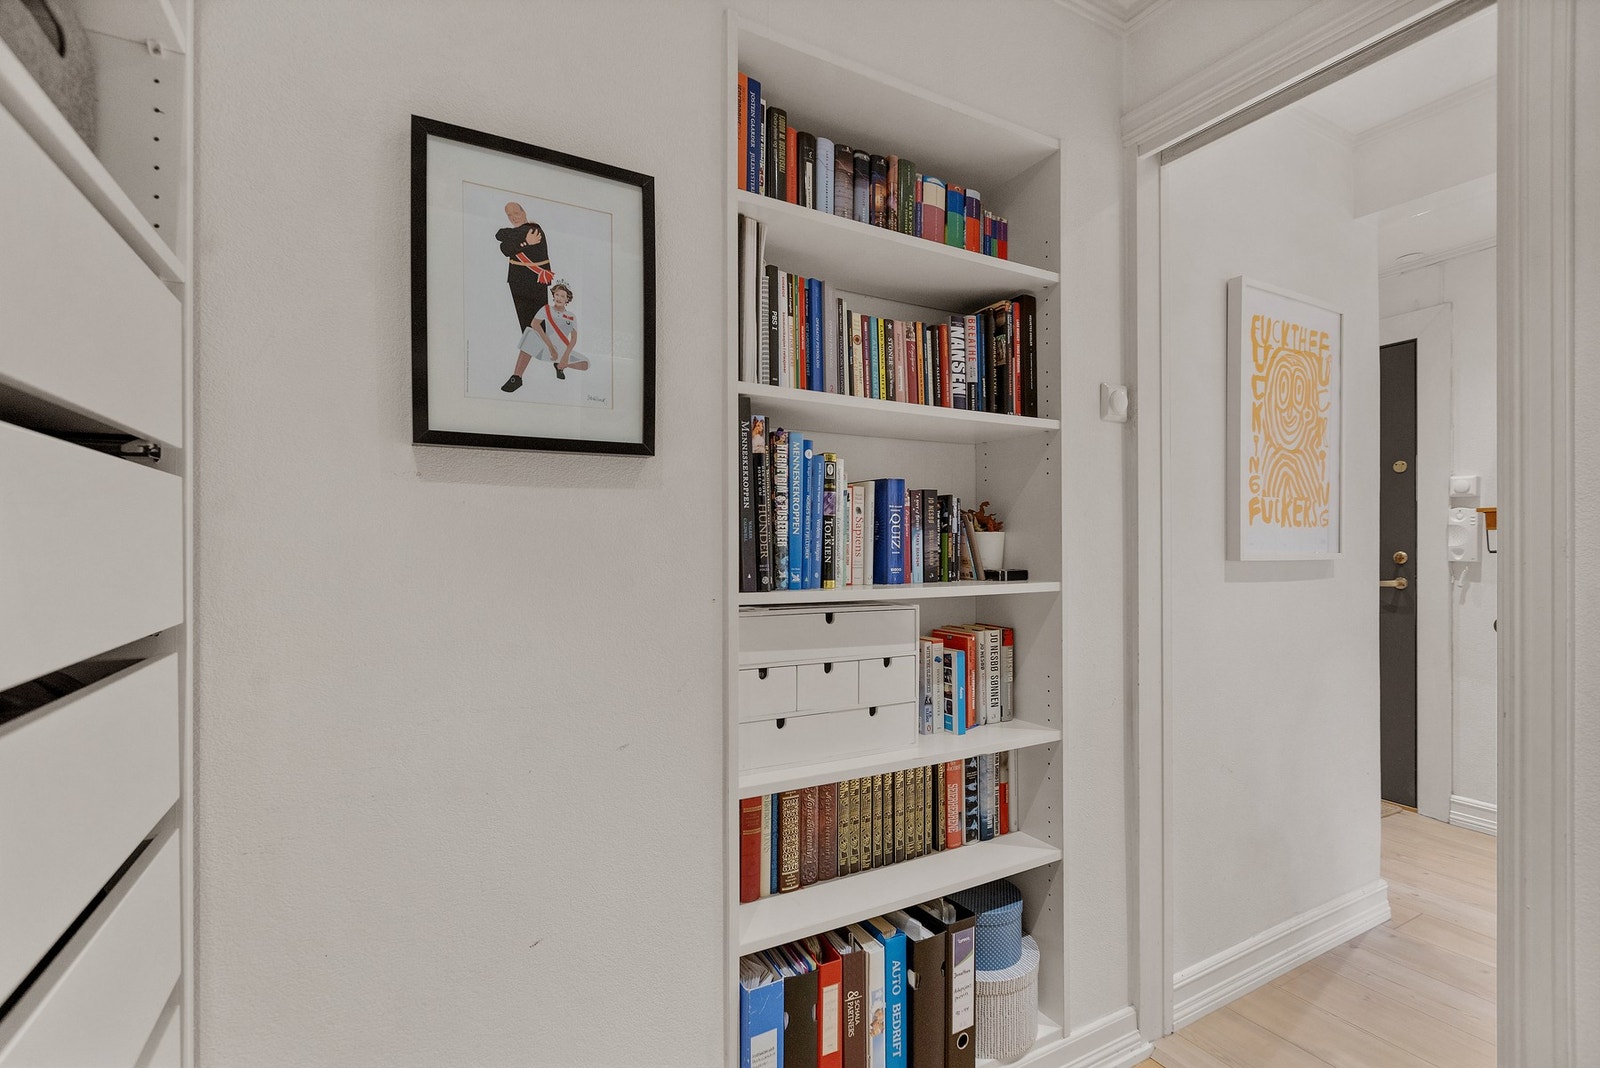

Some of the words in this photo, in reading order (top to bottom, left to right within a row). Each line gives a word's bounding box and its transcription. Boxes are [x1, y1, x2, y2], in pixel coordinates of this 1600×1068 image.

[967, 318, 977, 362] BREATHE
[951, 326, 966, 395] NANSEN
[740, 420, 750, 509] MENNESKEKROPPEN
[775, 444, 788, 493] HJERNETRIM
[792, 441, 801, 535] MENNESKEKROPPEN
[758, 504, 769, 559] HUNDER
[815, 518, 823, 539] Verdens
[889, 513, 902, 550] QUIZ
[928, 505, 936, 524] NESBØ
[1249, 498, 1317, 528] FUCKERS
[814, 540, 822, 562] viktigste
[824, 518, 834, 564] TOLKIEN
[853, 516, 865, 557] Sapiens
[980, 643, 985, 651] JO
[990, 633, 999, 643] JO
[990, 645, 999, 672] NESBØ
[990, 675, 999, 708] SØNNEN
[947, 783, 959, 833] SEIERHERRENE
[892, 960, 902, 996] AUTO
[846, 1001, 855, 1038] PARTNERS
[854, 999, 862, 1025] SCHALA
[892, 1002, 902, 1058] BEDRIFT
